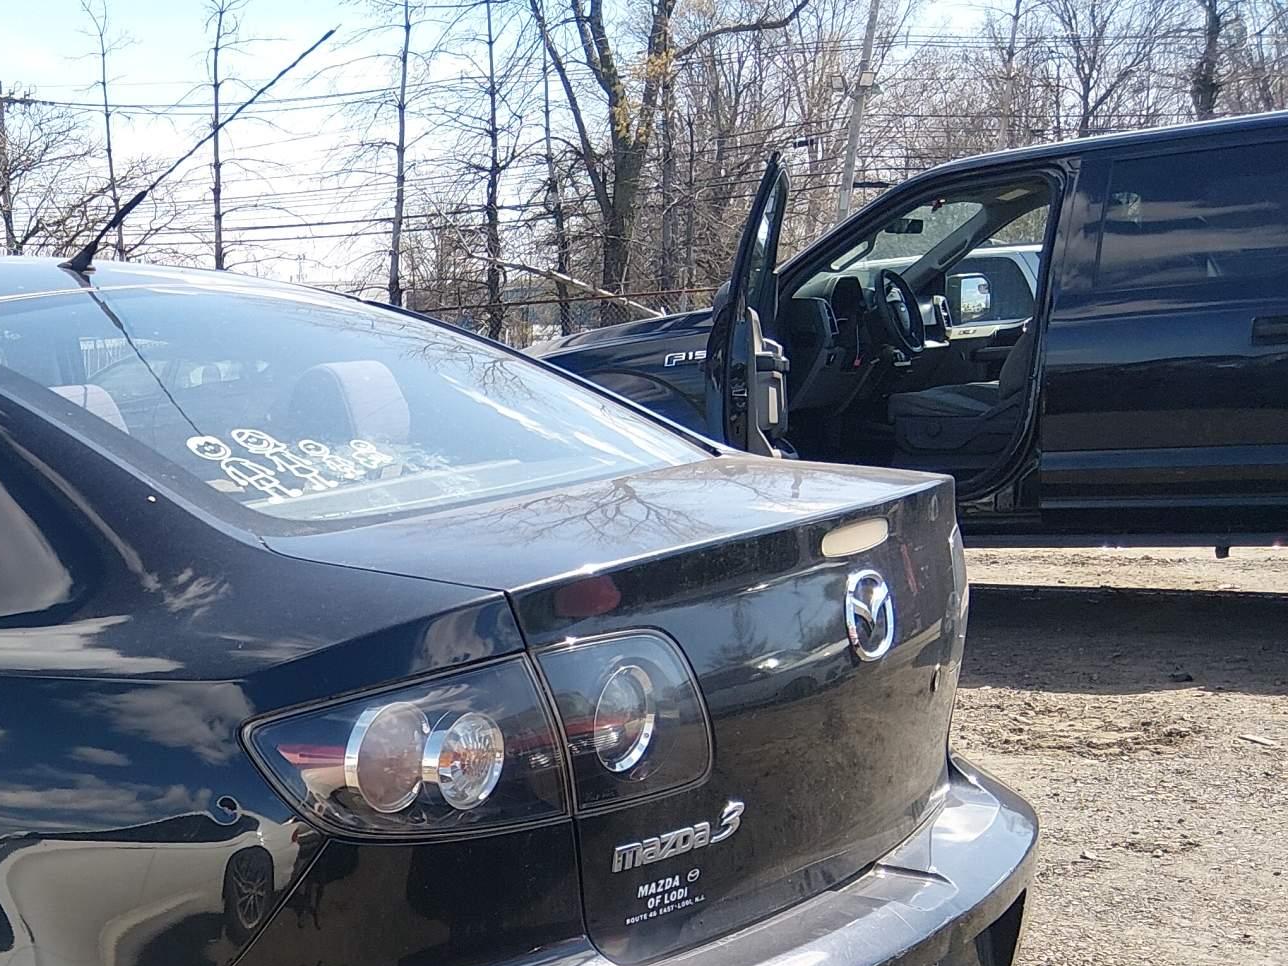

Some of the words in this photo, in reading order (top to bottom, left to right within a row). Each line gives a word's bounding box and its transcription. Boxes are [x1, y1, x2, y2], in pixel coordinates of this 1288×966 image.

[664, 350, 707, 367] F15
[637, 875, 680, 898] MAZDA
[647, 895, 662, 909] OF
[664, 886, 688, 904] LODI
[626, 913, 648, 925] ROUTE
